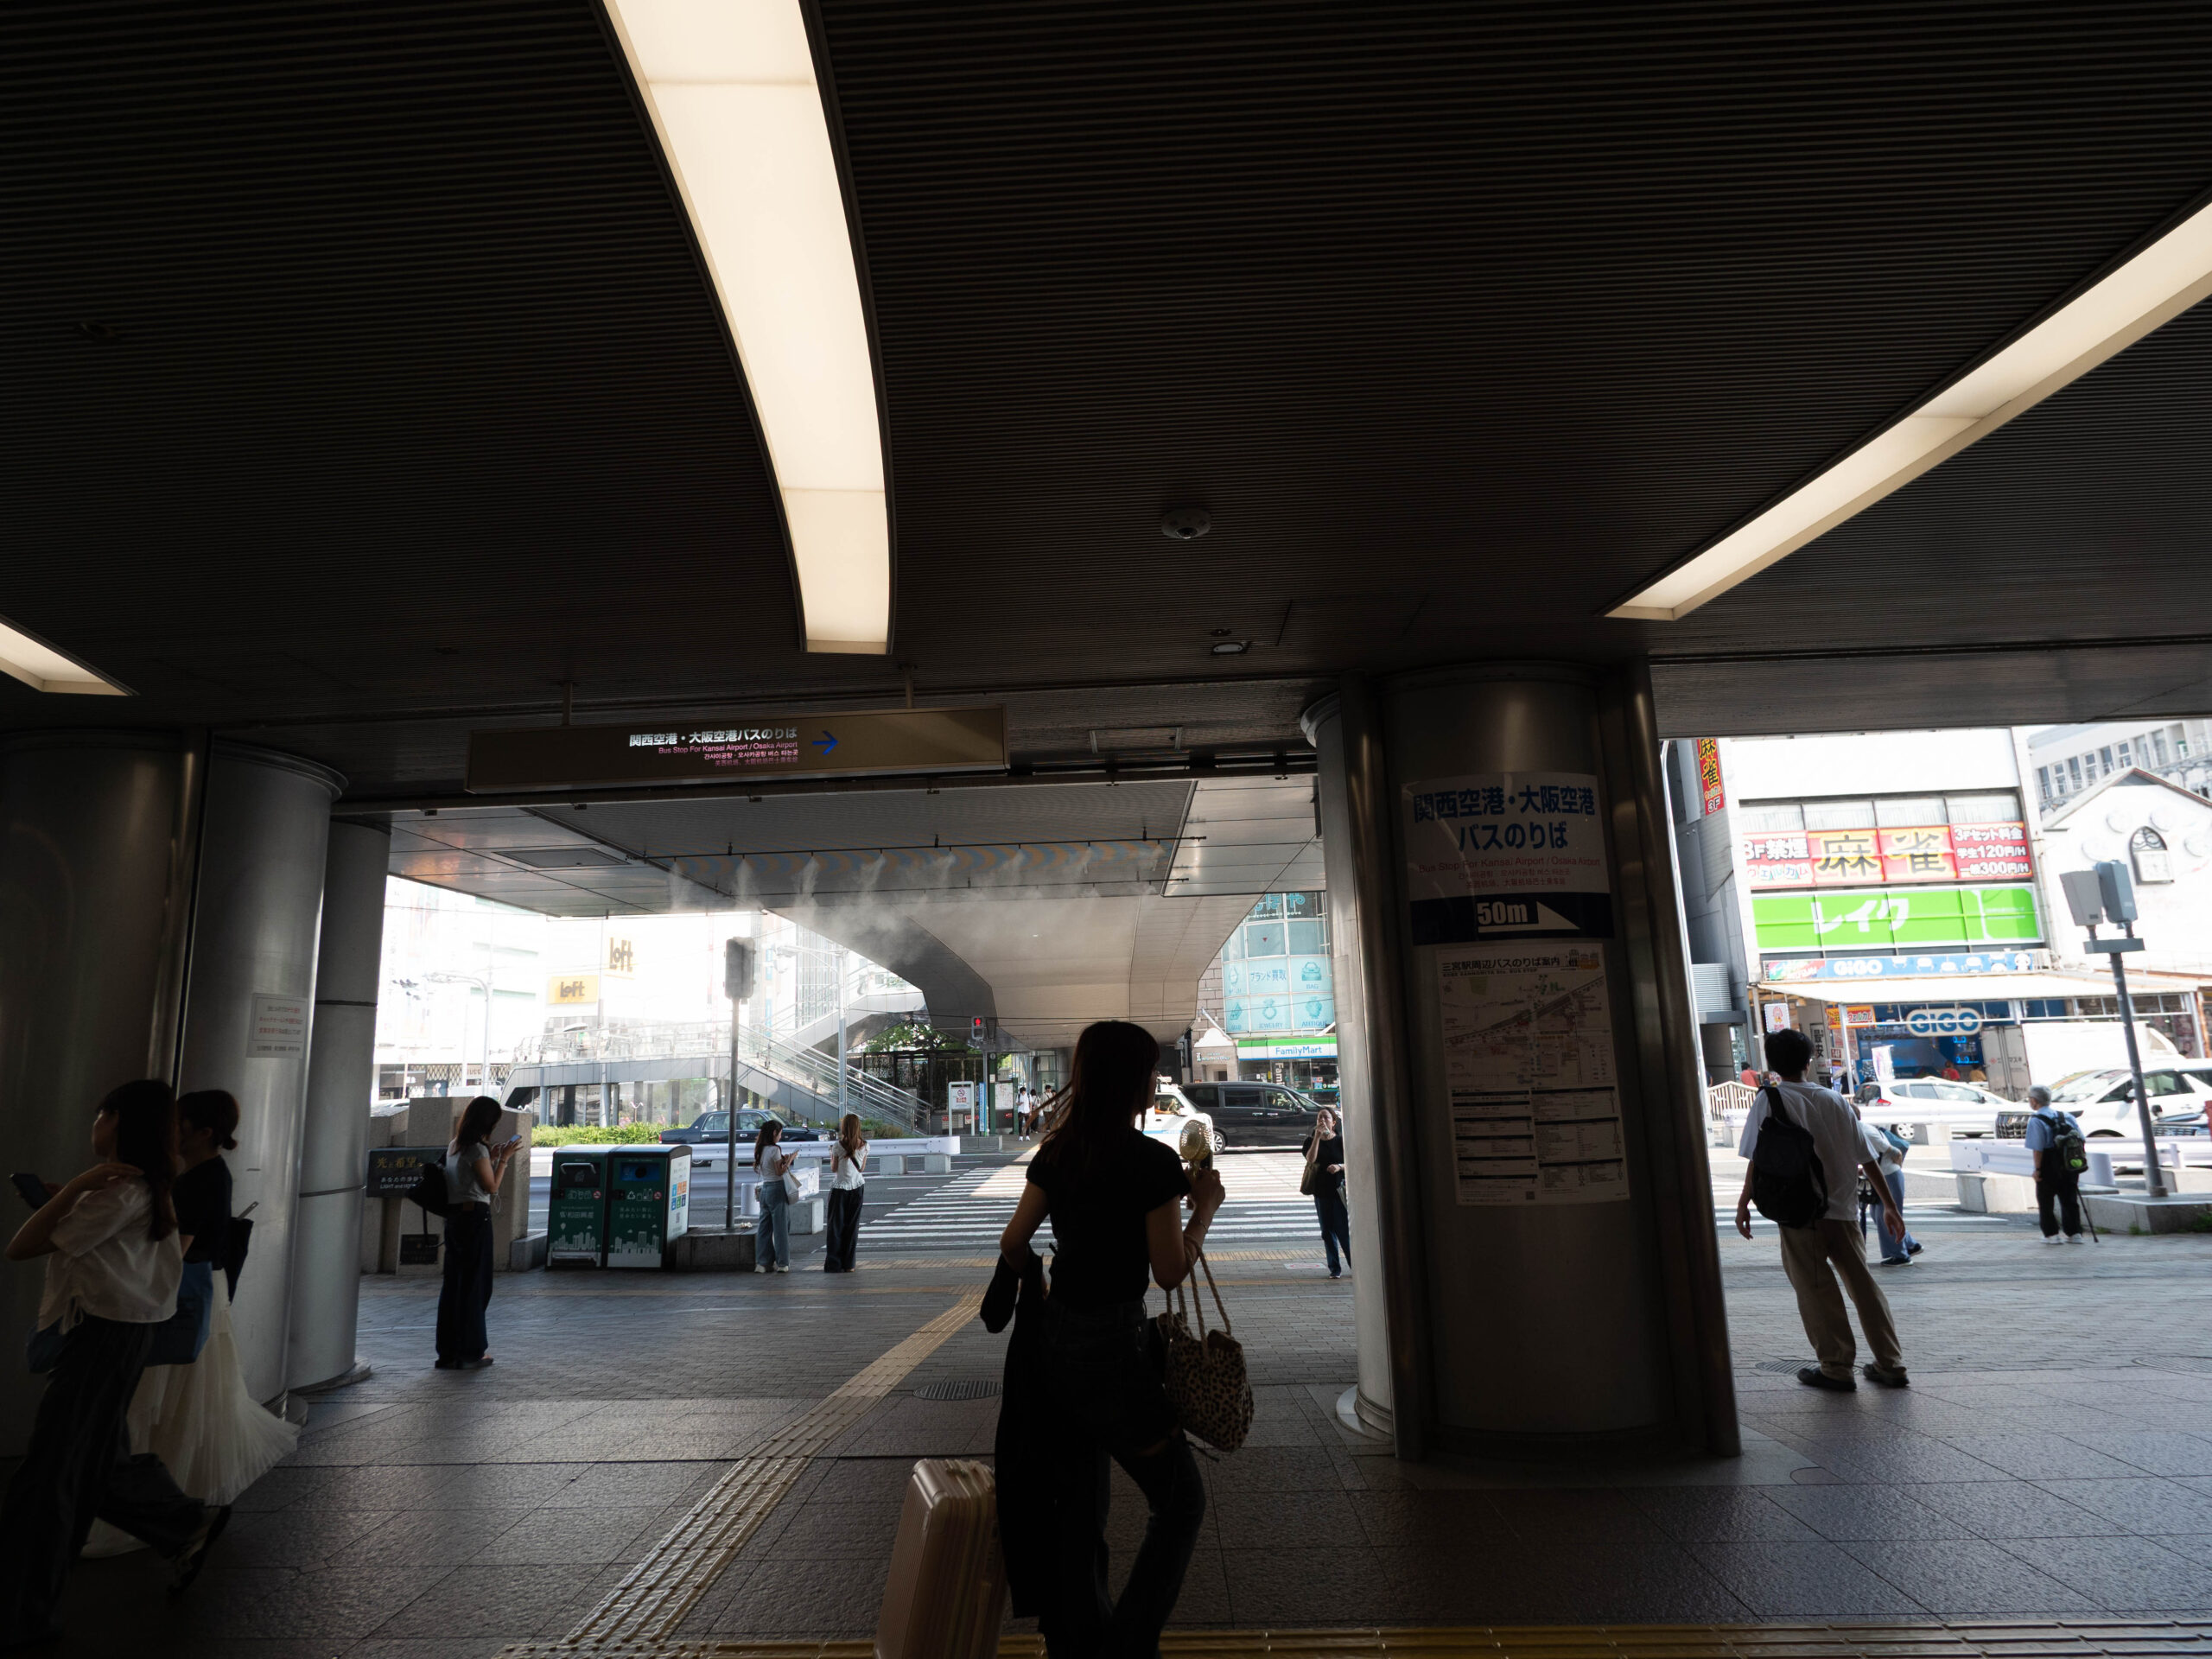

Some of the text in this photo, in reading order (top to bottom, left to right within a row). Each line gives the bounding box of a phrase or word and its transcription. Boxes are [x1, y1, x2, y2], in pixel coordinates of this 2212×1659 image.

[673, 746, 689, 755] Stop
[726, 742, 748, 752] Airport
[776, 741, 798, 749] Airport
[1413, 785, 1596, 823] 関西空港・大阪空港
[1707, 797, 1720, 812] 3F
[1459, 821, 1568, 851] バスのりば
[1418, 862, 1436, 873] Bus
[1438, 861, 1460, 873] Stop
[1462, 860, 1478, 868] For
[1481, 856, 1513, 868] Kansai
[1516, 855, 1544, 868] Airport
[1551, 855, 1577, 865] Osaka
[1578, 855, 1600, 867] Airport
[1817, 831, 1947, 880] 麻雀
[1476, 900, 1528, 925] 50m
[1811, 898, 1910, 934] レイク
[1250, 969, 1287, 982] ブランド買取
[1275, 1046, 1323, 1056] FamilyMart
